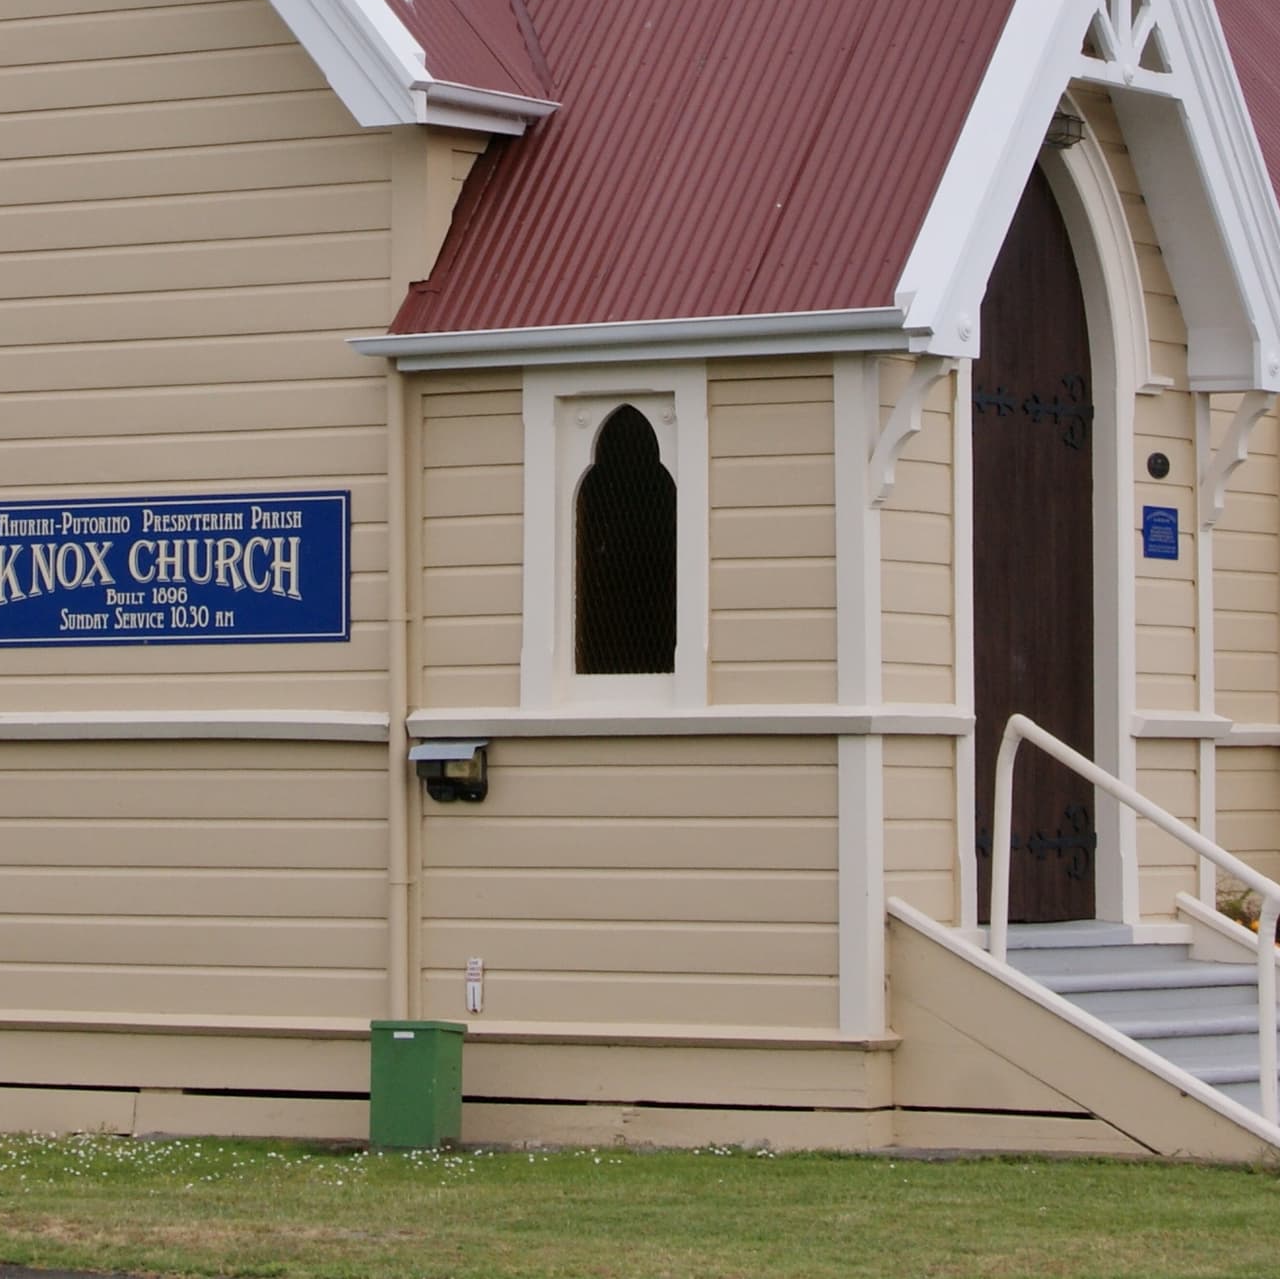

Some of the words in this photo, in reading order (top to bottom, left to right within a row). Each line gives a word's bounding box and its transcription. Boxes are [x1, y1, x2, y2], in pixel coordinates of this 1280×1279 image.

[142, 509, 243, 532] PRESBYTERIAN
[251, 506, 302, 529] PARISH
[128, 536, 302, 601] CHURCH
[106, 589, 145, 605] BUILT
[152, 587, 188, 604] 1896
[60, 608, 109, 631] SUNDAY
[114, 607, 164, 629] SERVICE
[171, 606, 209, 628] 10.30
